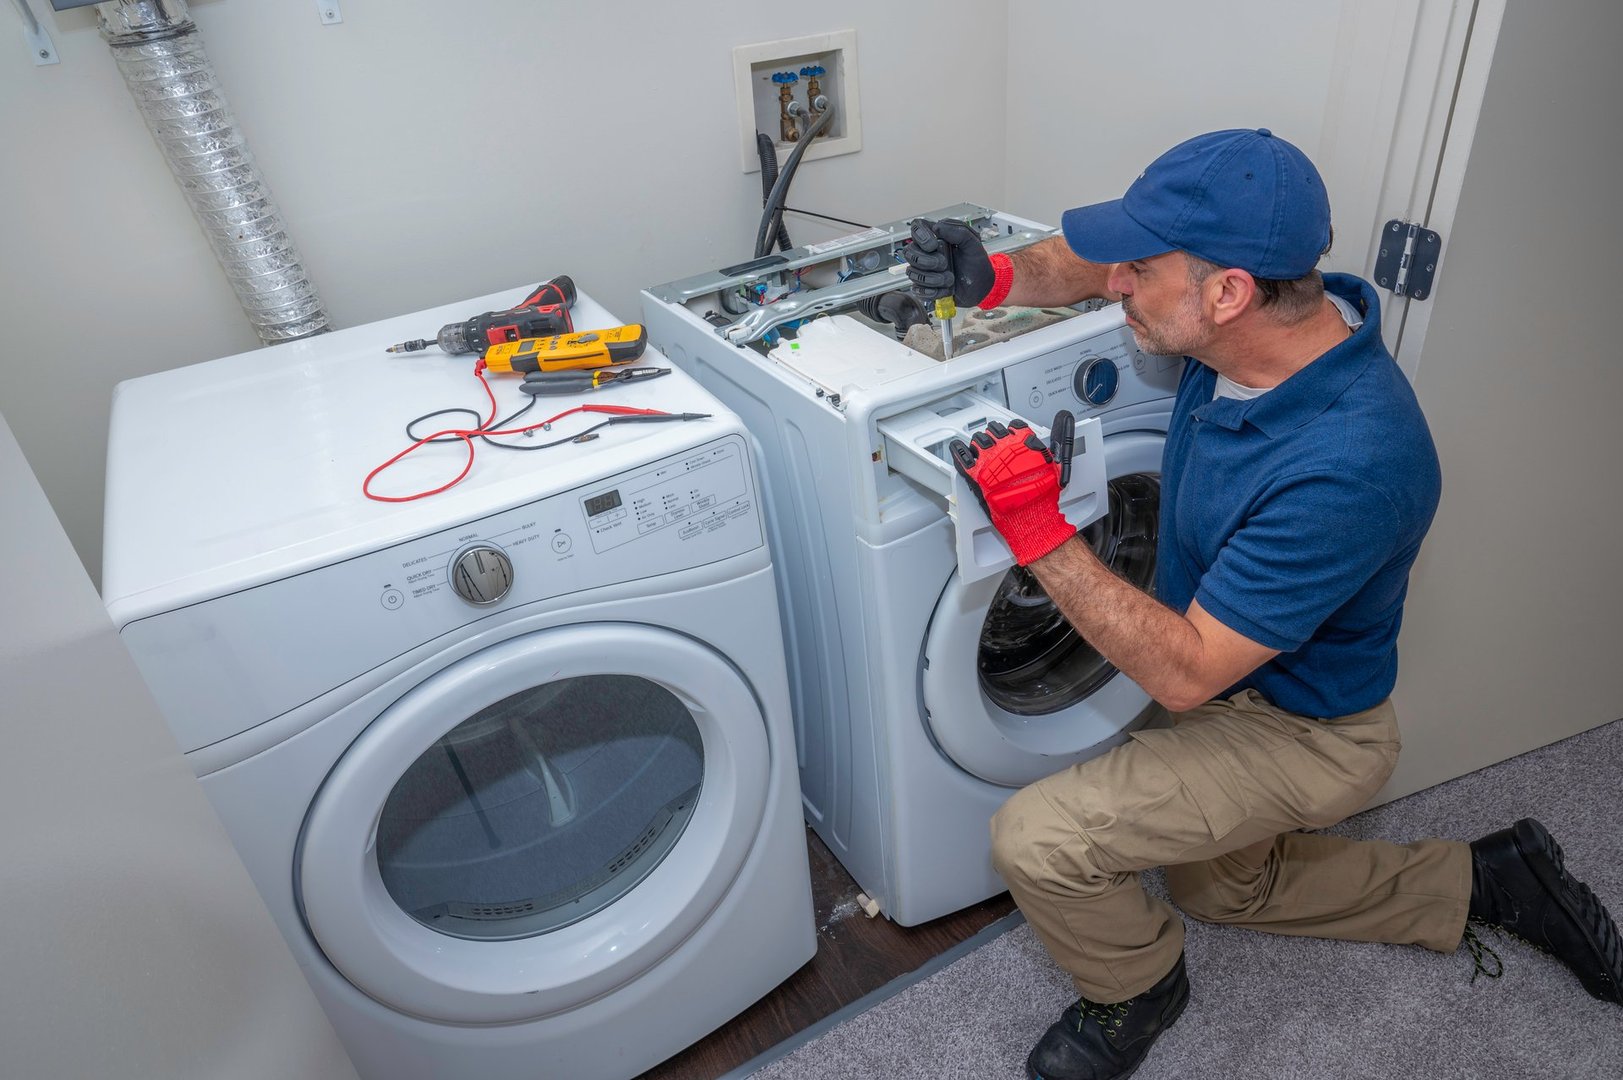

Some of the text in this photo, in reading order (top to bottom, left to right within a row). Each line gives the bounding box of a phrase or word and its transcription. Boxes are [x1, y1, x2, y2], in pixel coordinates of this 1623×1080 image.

[522, 522, 536, 530] BULKY
[458, 533, 478, 542] NORMAL
[512, 534, 540, 546] HEAVY DUTY
[402, 557, 428, 568] DELICATES
[406, 572, 422, 581] QUICK
[412, 586, 427, 595] TIMED
